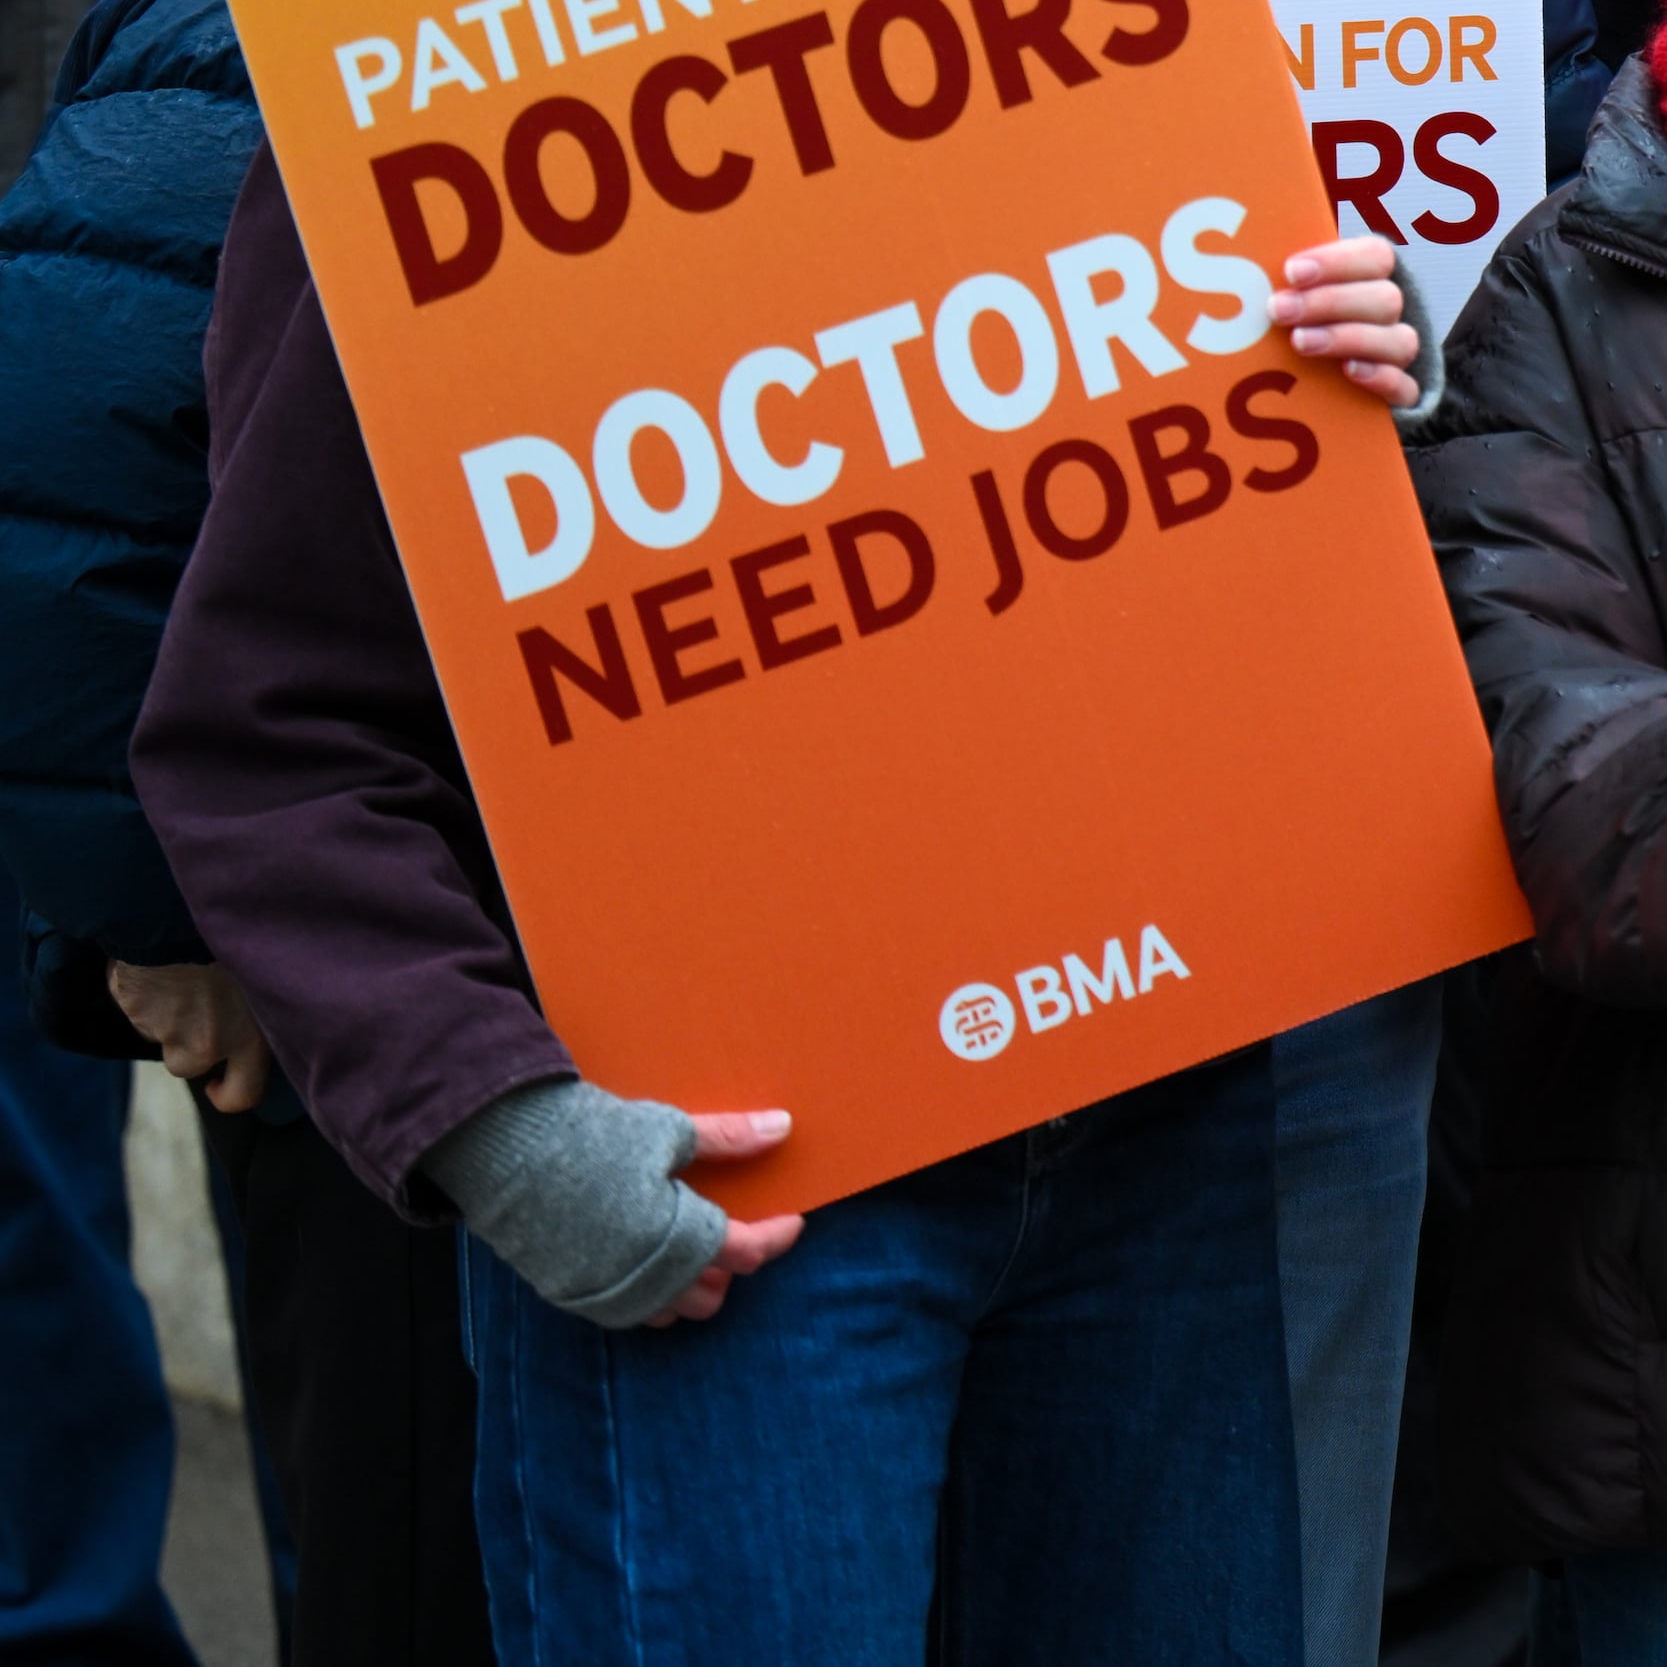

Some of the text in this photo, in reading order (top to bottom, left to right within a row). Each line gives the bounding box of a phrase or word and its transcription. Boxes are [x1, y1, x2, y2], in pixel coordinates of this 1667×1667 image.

[1342, 15, 1499, 88] FOR
[461, 197, 1272, 601] DOCTORS
[516, 369, 1320, 747] NEED JOBS
[1015, 925, 1190, 1033] BMA
